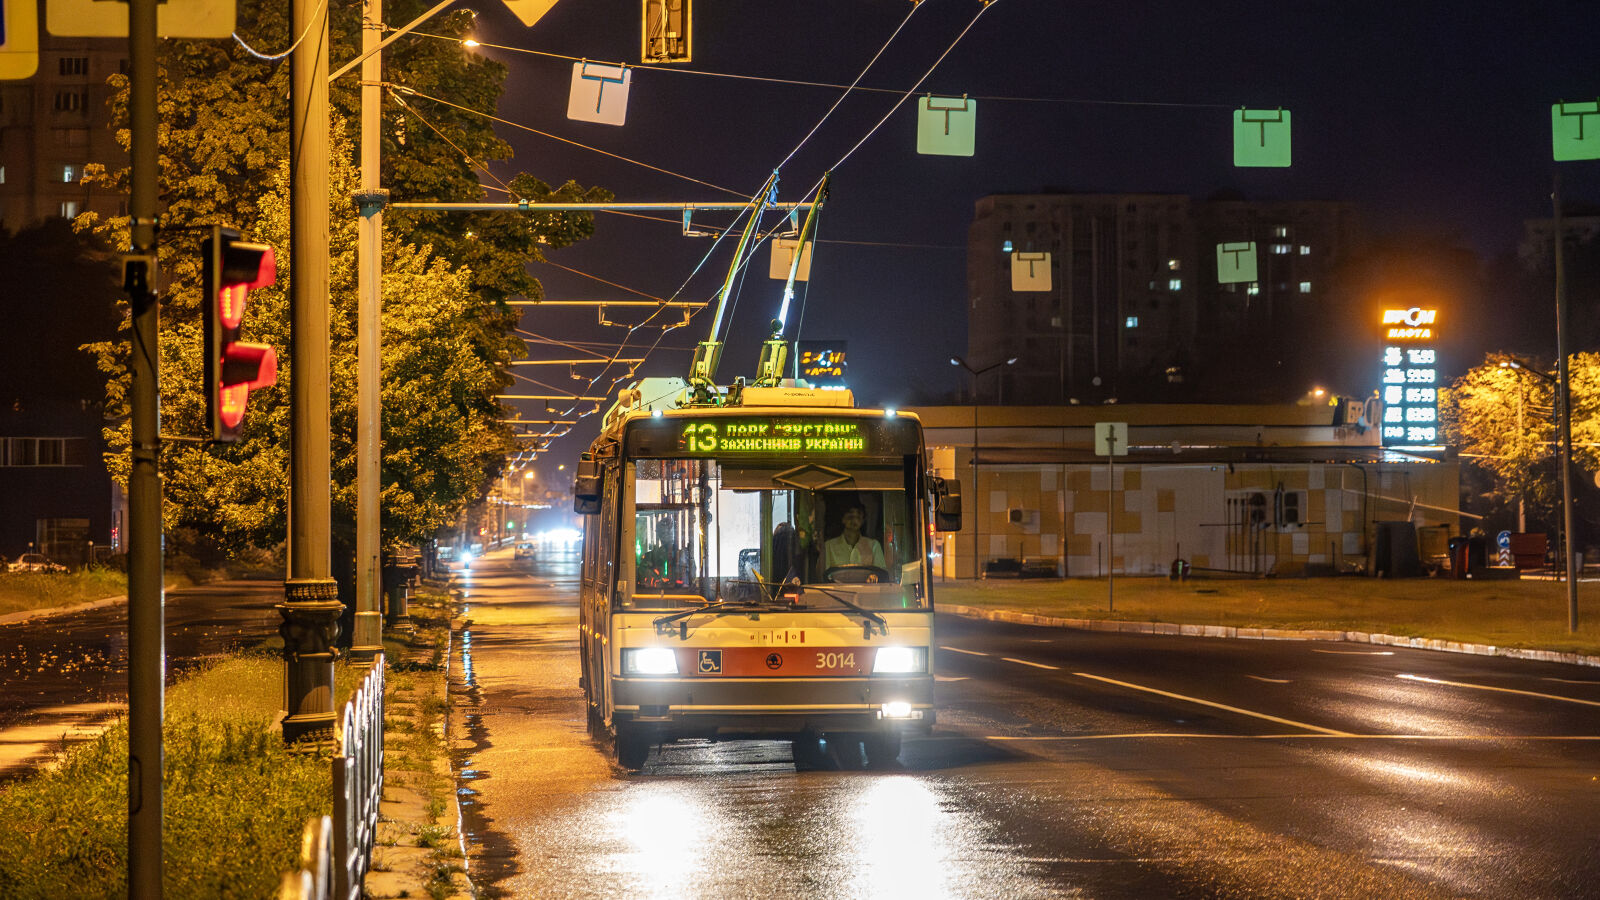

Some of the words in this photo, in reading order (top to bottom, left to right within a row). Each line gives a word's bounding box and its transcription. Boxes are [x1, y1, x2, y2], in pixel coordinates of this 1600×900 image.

[682, 423, 717, 451] 13
[727, 424, 768, 436] ПАРК
[720, 438, 801, 450] ЗАХИСНИКІВ
[806, 437, 863, 450] УКРАЇНИ
[815, 653, 856, 669] 3014
